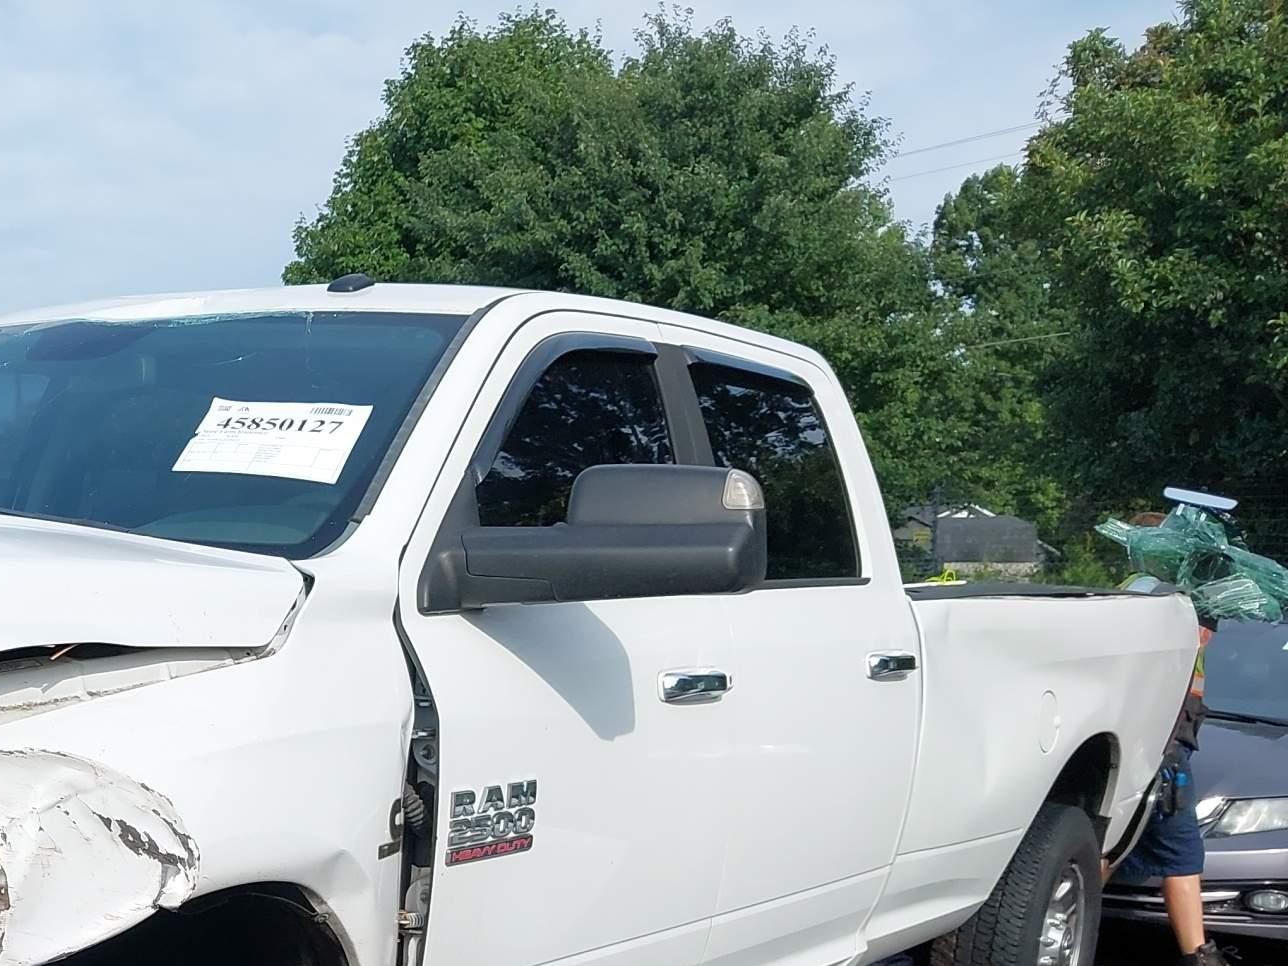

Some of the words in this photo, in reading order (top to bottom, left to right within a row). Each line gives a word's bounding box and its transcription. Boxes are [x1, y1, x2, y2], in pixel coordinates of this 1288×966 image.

[216, 417, 344, 434] 45850127
[450, 779, 537, 819] RAM
[447, 807, 536, 847] 2500
[452, 844, 496, 862] HEAVY
[497, 839, 529, 852] DUTY
